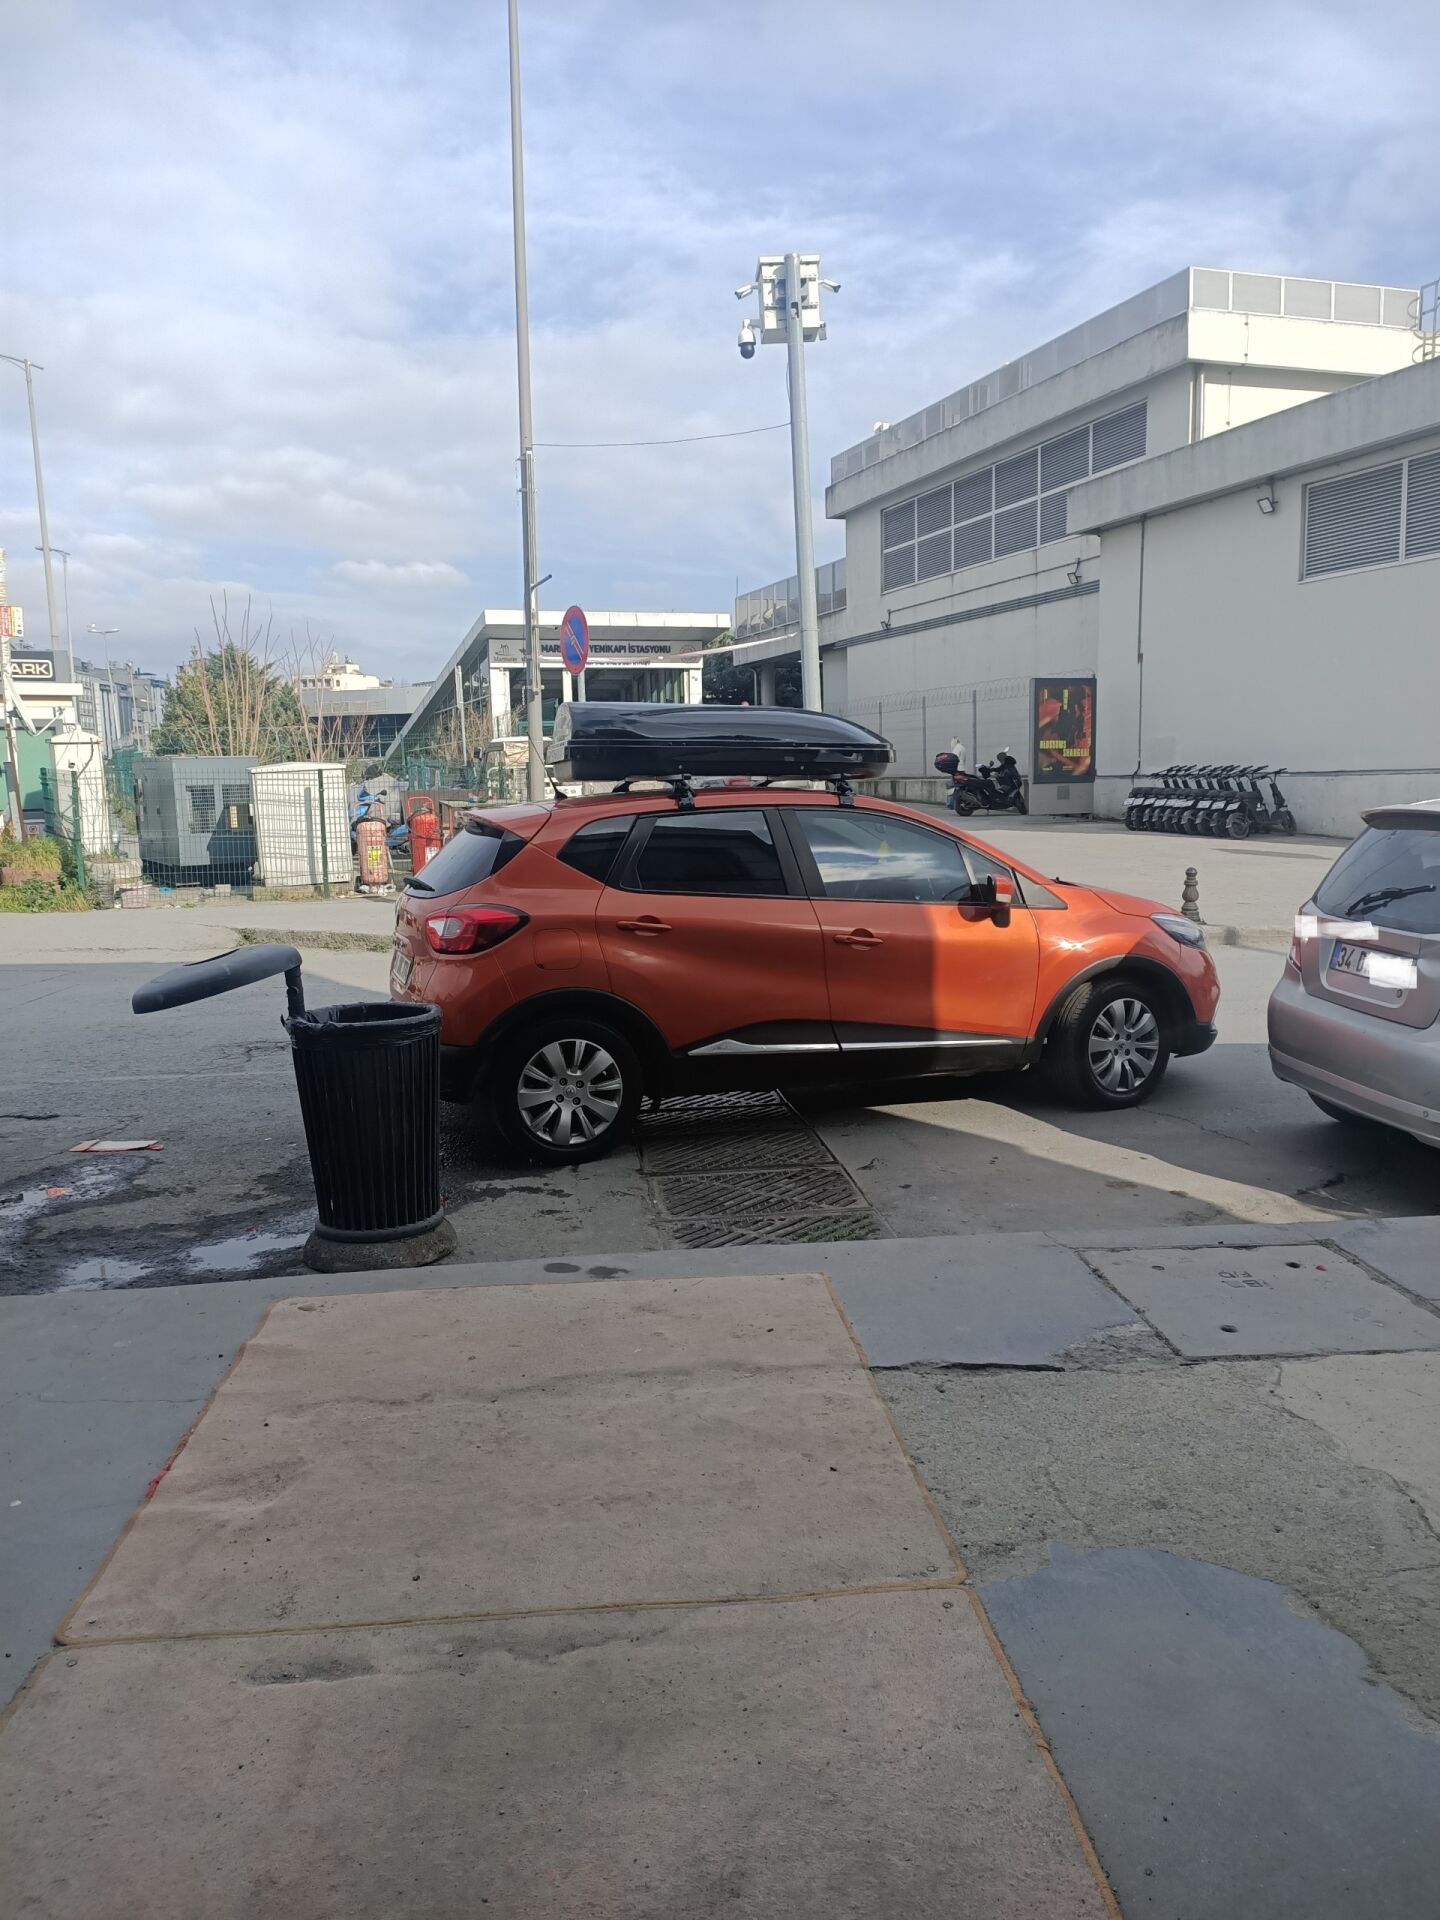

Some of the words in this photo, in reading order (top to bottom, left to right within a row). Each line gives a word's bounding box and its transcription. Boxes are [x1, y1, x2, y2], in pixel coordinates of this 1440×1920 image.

[589, 643, 626, 653] YENİKAPI
[628, 642, 671, 653] İSTASYONU
[10, 663, 49, 675] ARK
[1337, 947, 1355, 968] 34
